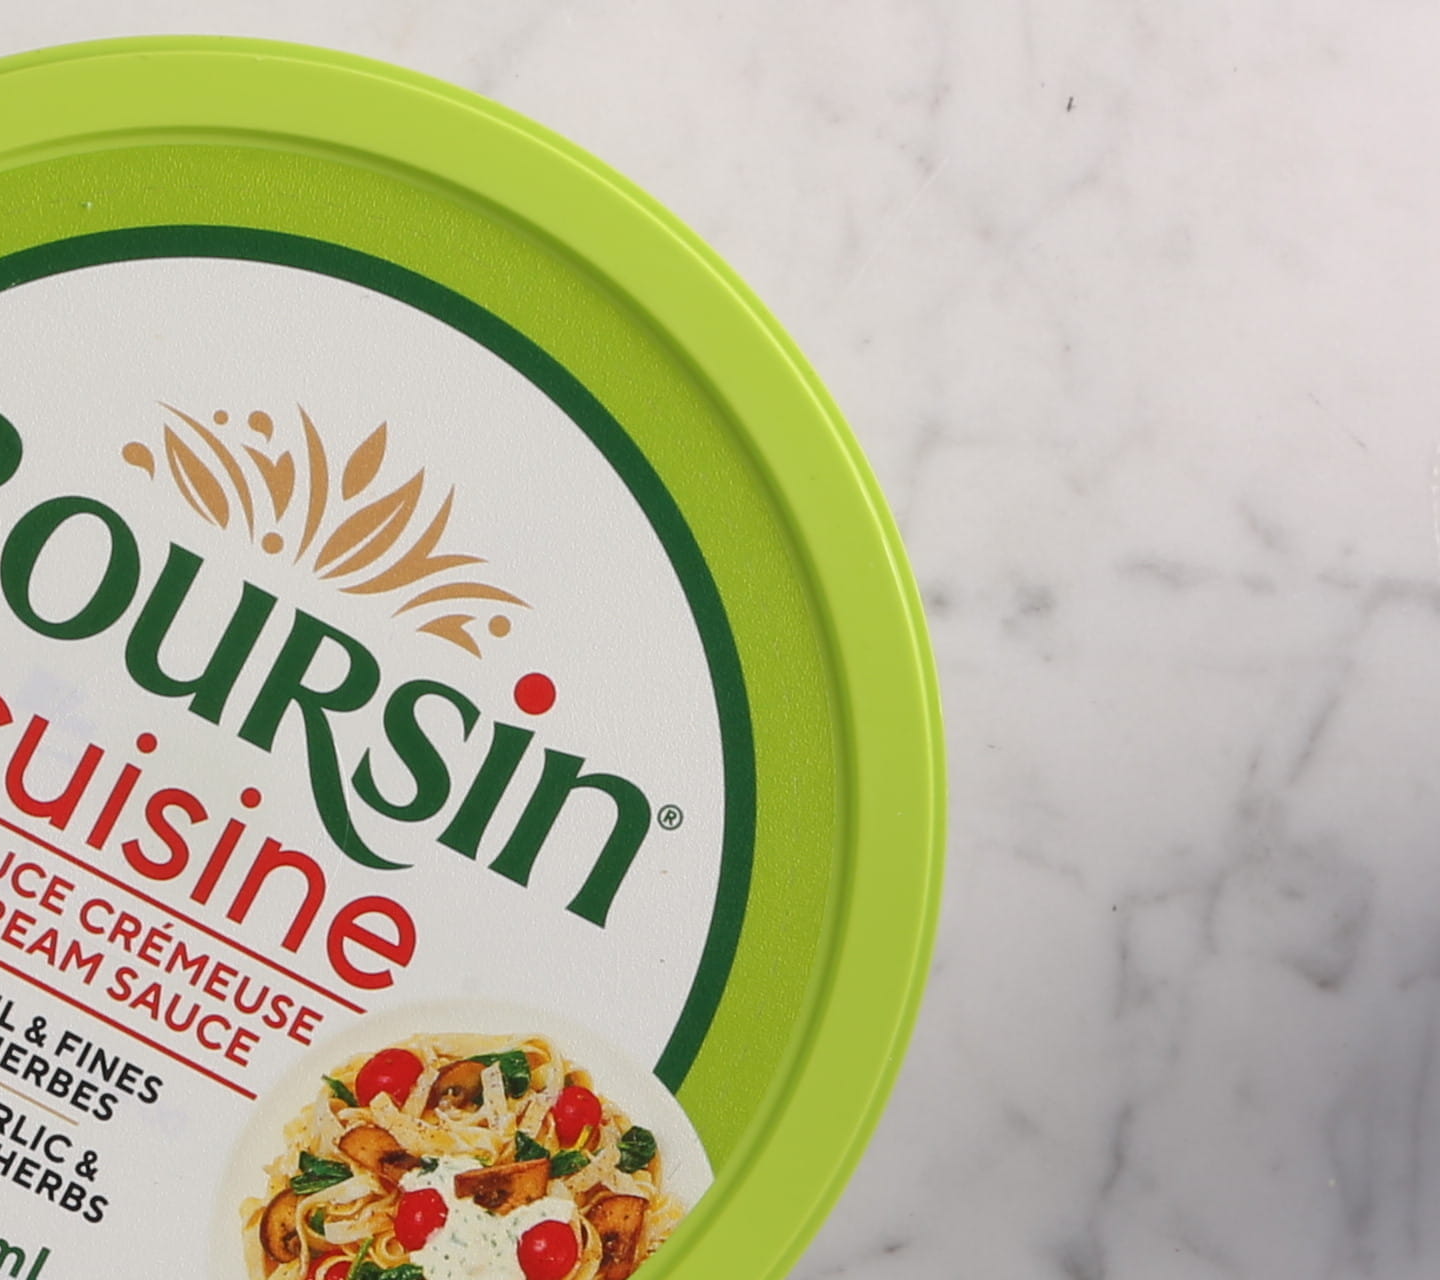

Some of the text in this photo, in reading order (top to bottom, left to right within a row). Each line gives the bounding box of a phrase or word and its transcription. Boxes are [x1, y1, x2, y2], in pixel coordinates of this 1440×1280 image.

[80, 899, 323, 1045] CRÉMEUSE
[107, 967, 260, 1066] SAUCE
[25, 1016, 46, 1047] &
[55, 1031, 162, 1103] FINES
[75, 1151, 97, 1181] &
